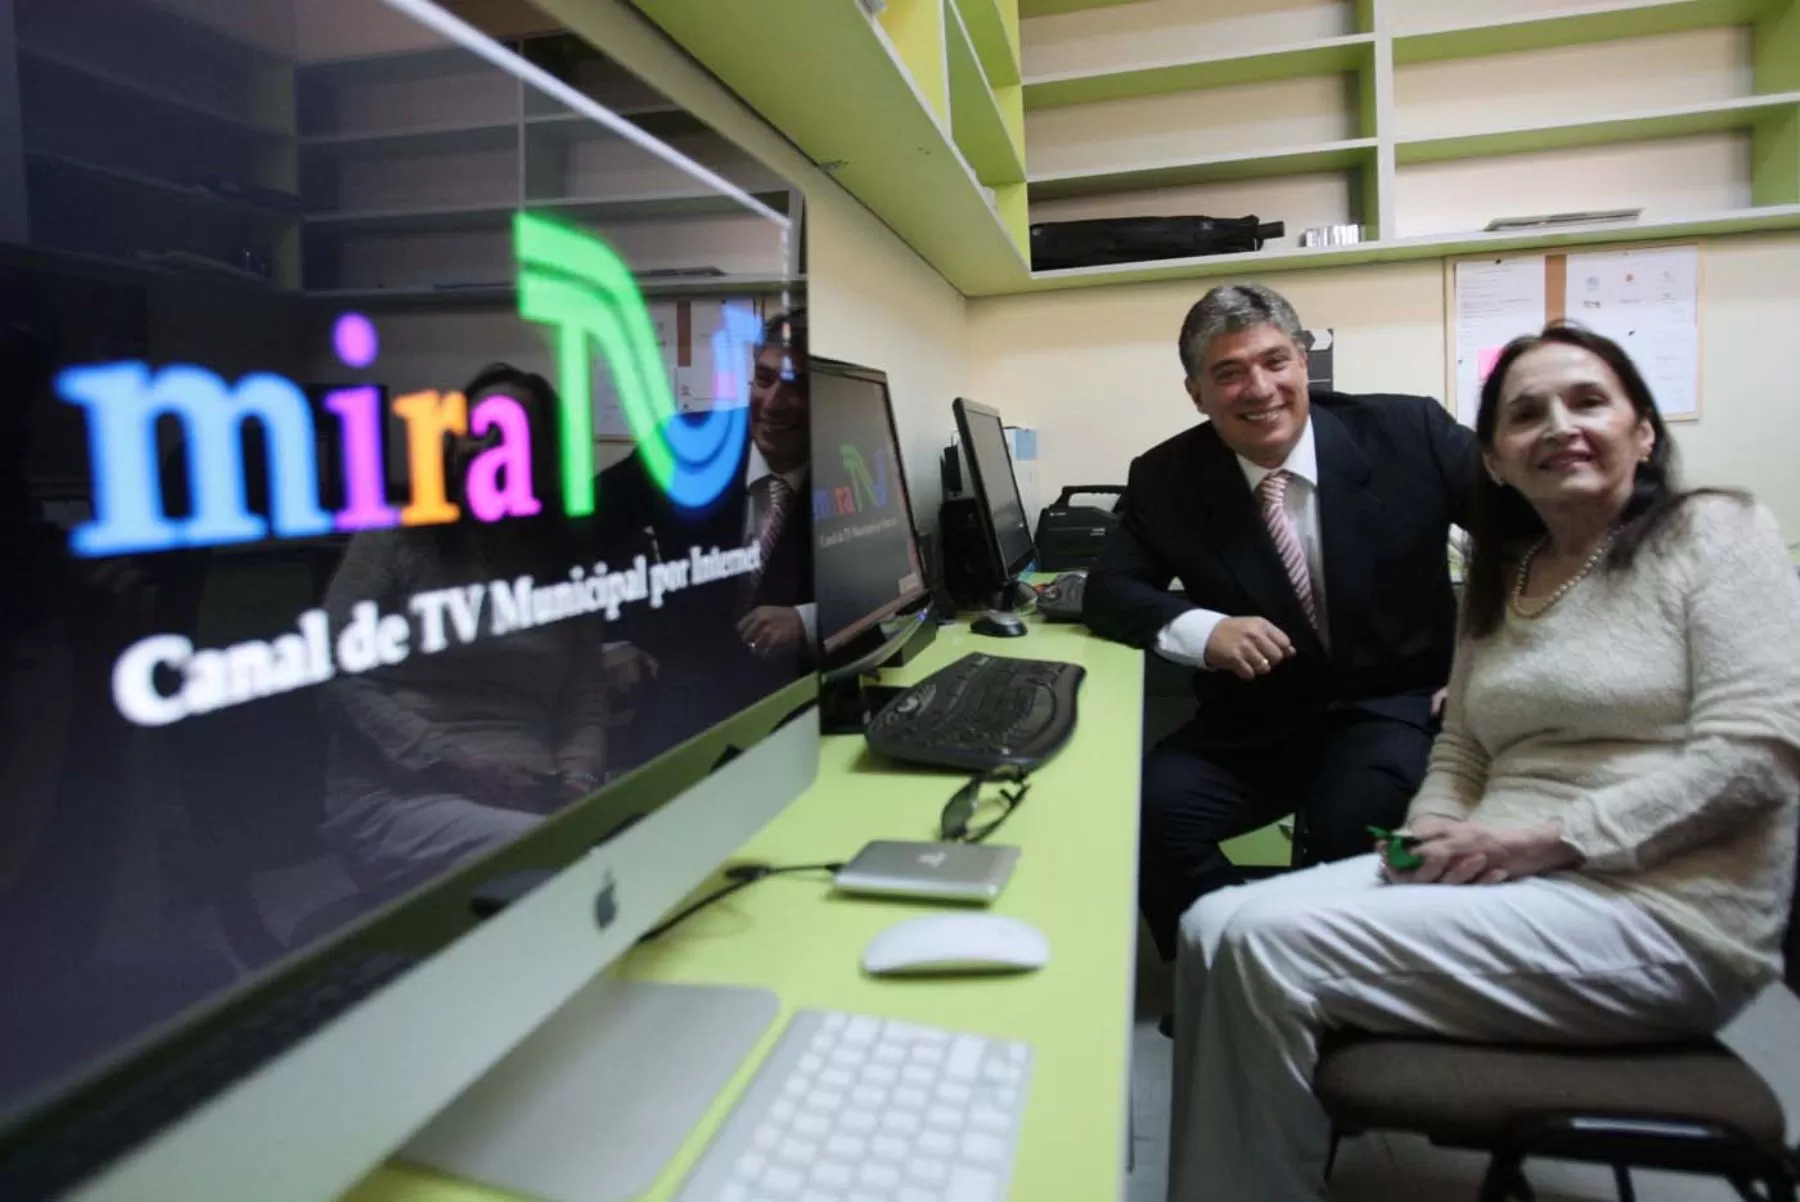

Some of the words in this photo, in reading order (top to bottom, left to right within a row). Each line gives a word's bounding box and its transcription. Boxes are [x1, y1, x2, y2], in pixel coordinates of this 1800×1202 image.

[111, 608, 335, 726] Canal
[336, 600, 410, 673] de
[409, 583, 486, 654] TV
[489, 554, 648, 635] Municipal
[649, 558, 690, 609] por
